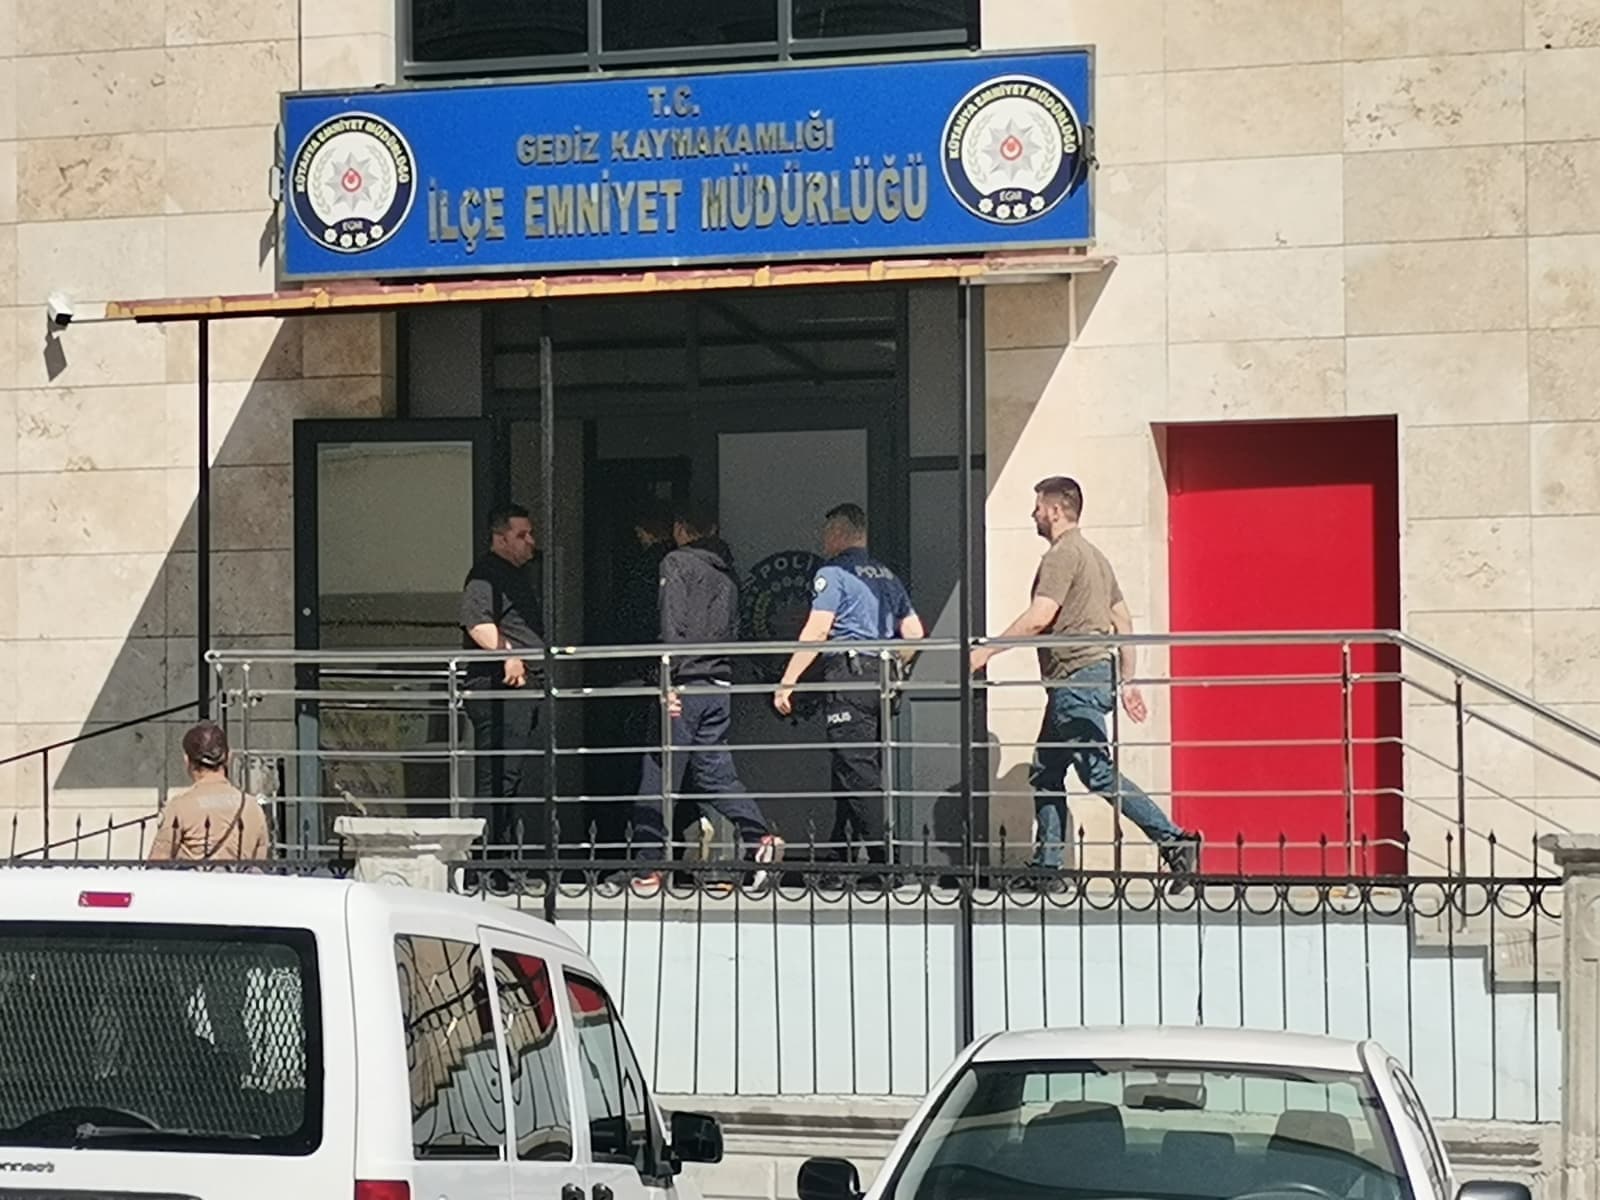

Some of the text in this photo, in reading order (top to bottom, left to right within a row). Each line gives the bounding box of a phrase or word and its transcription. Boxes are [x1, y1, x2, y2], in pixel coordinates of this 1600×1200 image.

[648, 86, 700, 117] T.C.
[516, 109, 835, 165] GEDİZ KAYMAKAMLIĞI
[427, 153, 929, 253] İLÇE EMNİYET MÜDÜRLÜĞÜ
[759, 554, 815, 579] POLI
